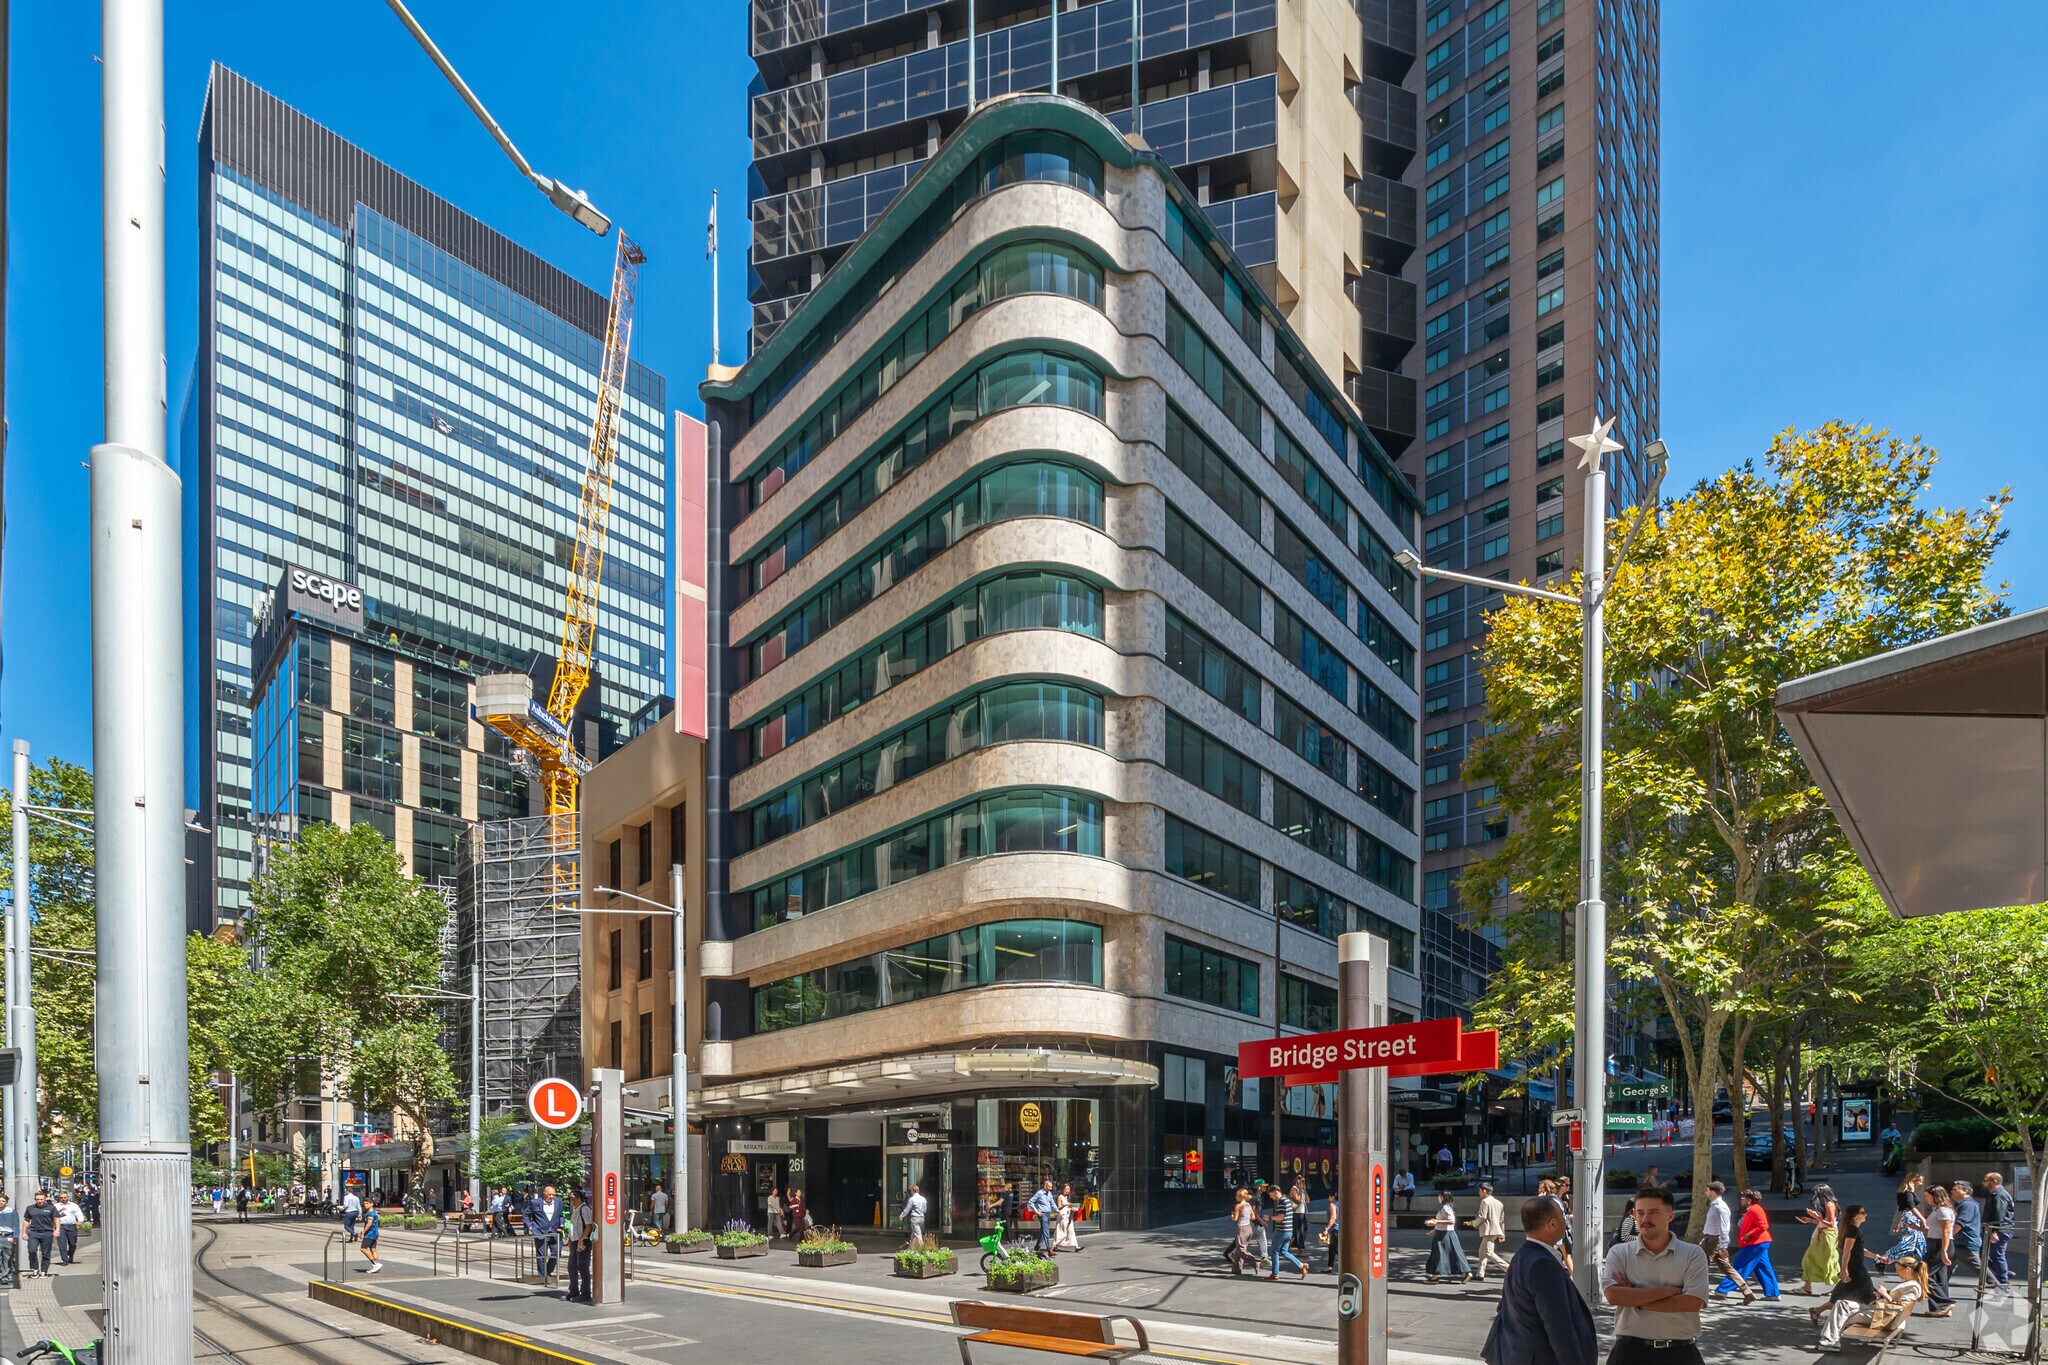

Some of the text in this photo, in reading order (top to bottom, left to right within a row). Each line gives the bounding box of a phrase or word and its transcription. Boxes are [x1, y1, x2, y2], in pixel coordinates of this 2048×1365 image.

[292, 570, 360, 608] scape
[1269, 1034, 1417, 1069] Bridge Street
[1622, 1084, 1669, 1097] George St
[547, 1088, 566, 1117] L
[1607, 1115, 1645, 1125] Jamison St
[789, 1158, 804, 1172] 261
